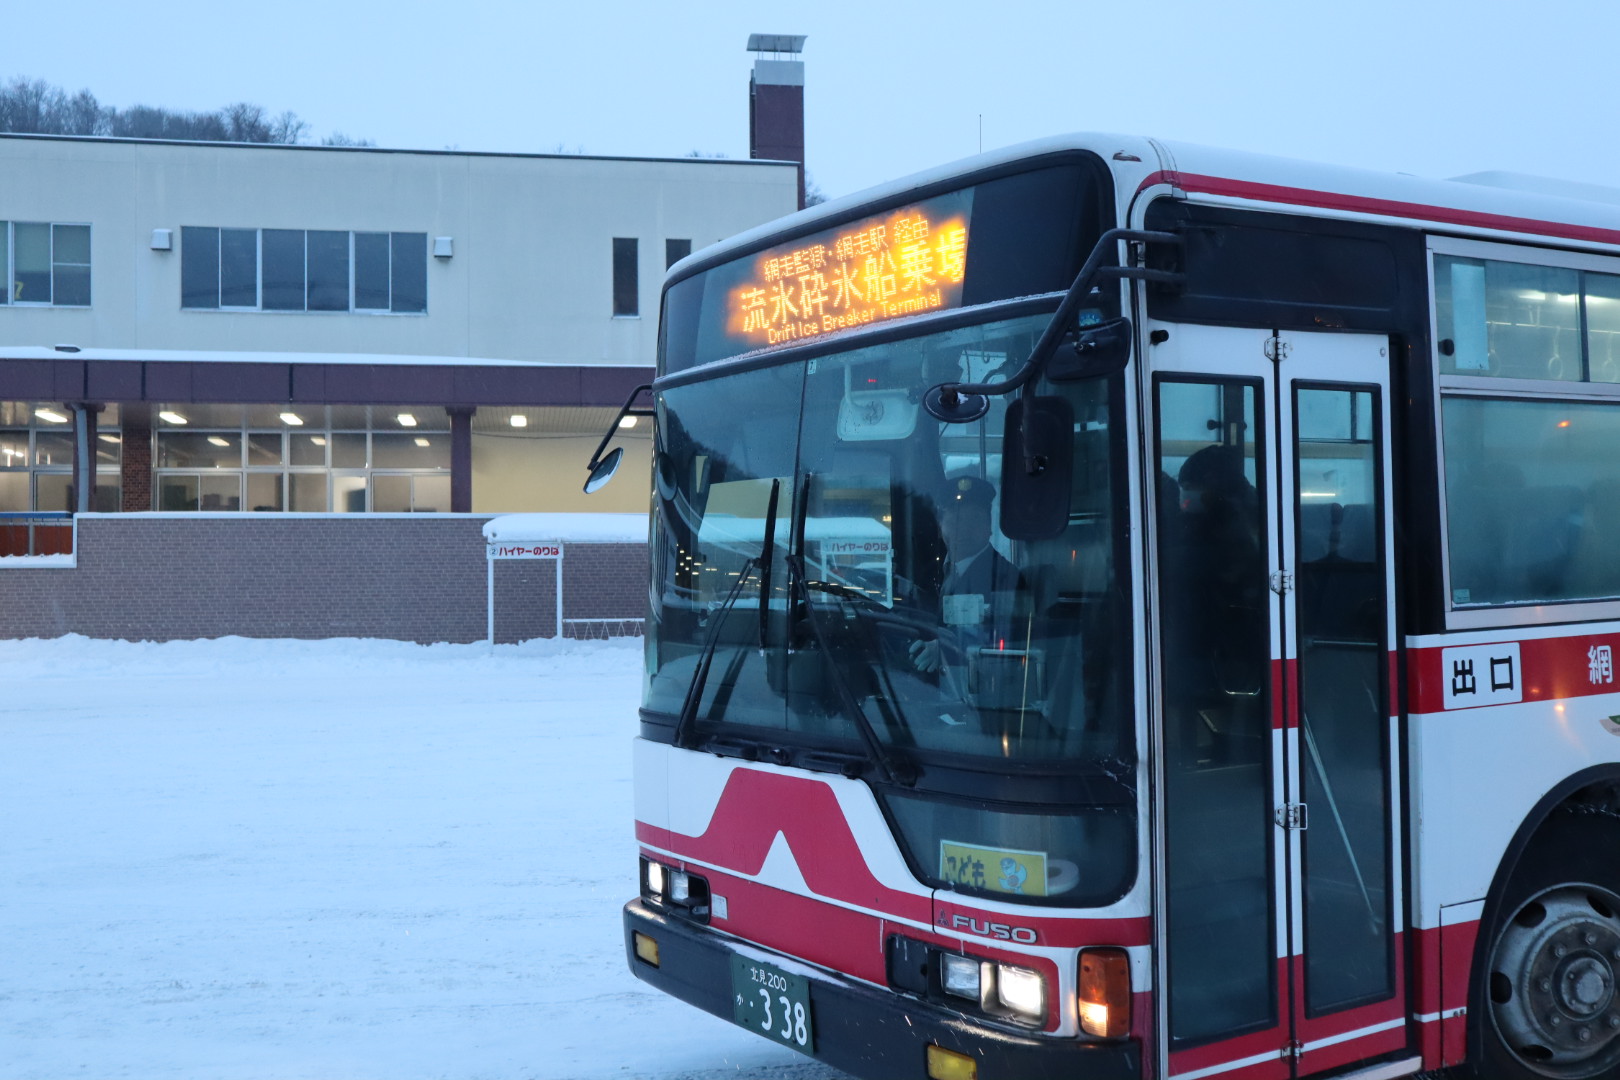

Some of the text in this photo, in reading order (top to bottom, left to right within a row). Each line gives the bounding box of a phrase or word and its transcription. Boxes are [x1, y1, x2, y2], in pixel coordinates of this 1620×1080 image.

[741, 227, 966, 333] 流氷砕氷船乗場
[768, 289, 942, 344] Drift Ice Breaker Terminal
[499, 546, 560, 556] ハイヤーのりば
[1452, 656, 1514, 696] 出口
[1587, 645, 1613, 684] 網
[952, 914, 1037, 944] FUSO
